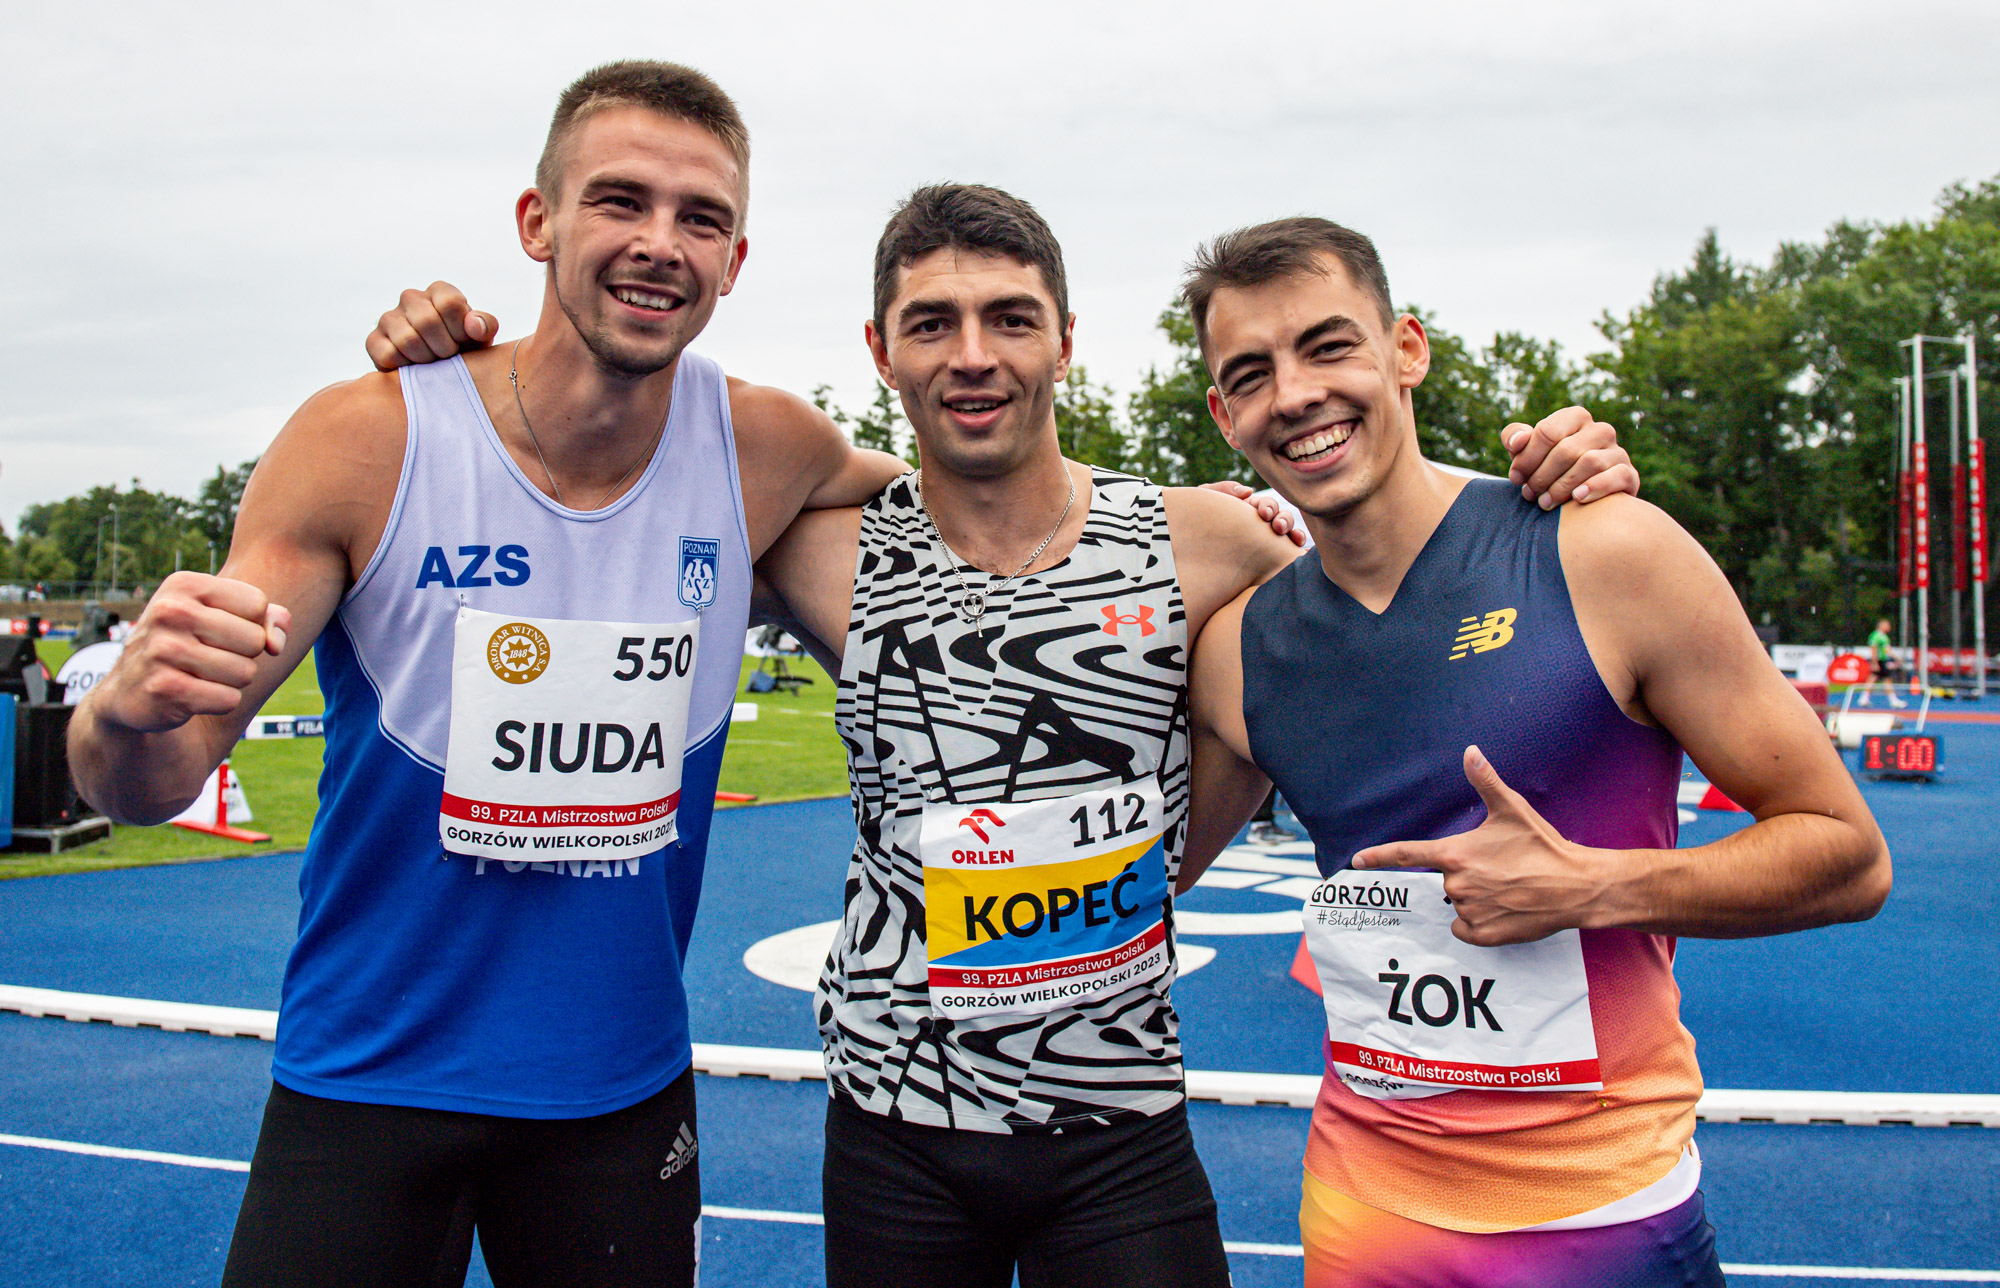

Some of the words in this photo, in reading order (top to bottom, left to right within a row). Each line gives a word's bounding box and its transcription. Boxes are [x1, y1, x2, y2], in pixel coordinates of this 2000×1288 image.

[415, 544, 531, 589] AZS
[490, 629, 510, 671] BROWAR
[511, 625, 548, 656] WITNICA
[509, 648, 528, 659] 1848
[612, 634, 693, 682] 550
[66, 671, 109, 690] GO
[491, 720, 665, 774] SIUDA
[1866, 736, 1935, 771] 1:00
[470, 804, 495, 821] 99.
[499, 808, 538, 824] PZLA
[542, 810, 637, 824] Mistrzostwa
[639, 799, 669, 820] Polski
[1069, 792, 1149, 848] 112
[447, 826, 527, 849] GORZÓW
[532, 829, 653, 849] WIELKOPOLSKI
[952, 849, 1015, 865] ORLEN
[964, 860, 1140, 941] KOPEĆ
[1311, 880, 1409, 908] GORZÓW
[941, 993, 1017, 1008] GORZÓW
[1020, 968, 1132, 1004] WIELKOPOLSKI
[1133, 952, 1162, 976] 2023
[962, 972, 984, 986] 99.
[987, 972, 1022, 986] PZLA
[1026, 958, 1112, 982] Mistrzostwa
[1114, 938, 1146, 965] Polski
[1378, 958, 1505, 1032] ŻOK
[1358, 1049, 1376, 1067] 99.
[1376, 1054, 1406, 1075] PZLA
[1409, 1061, 1505, 1085] Mistrzostwa
[1510, 1067, 1561, 1084] Polski
[660, 1140, 698, 1180] adidas
